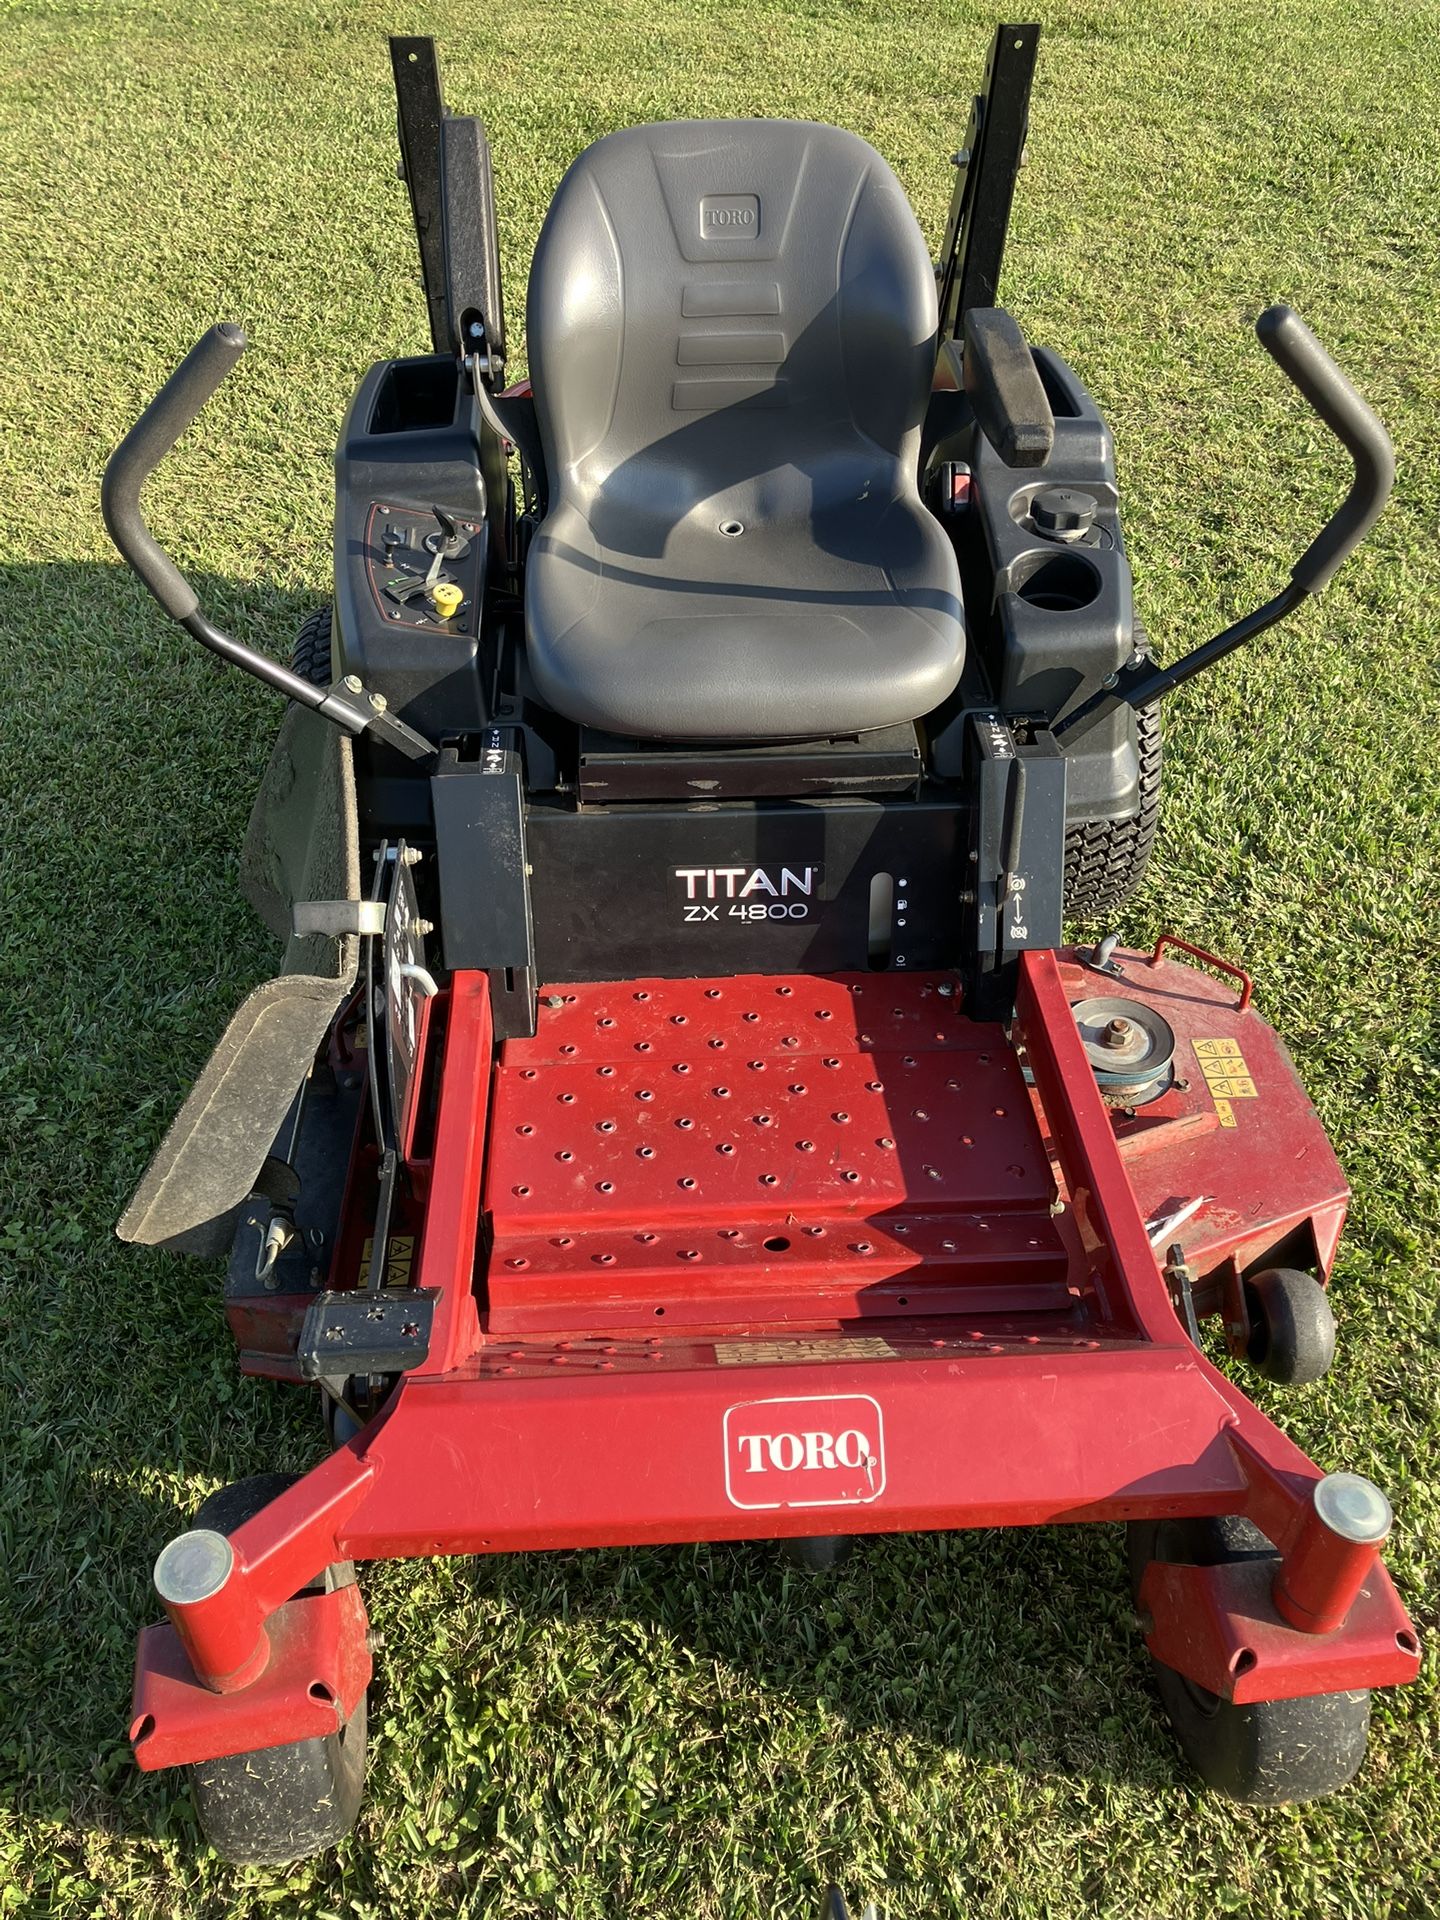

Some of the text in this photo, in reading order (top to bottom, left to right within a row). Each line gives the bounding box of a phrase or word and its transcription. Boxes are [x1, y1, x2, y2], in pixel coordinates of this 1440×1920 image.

[705, 208, 755, 226] TORO
[675, 867, 812, 899] TITAN
[683, 903, 809, 922] ZX 4800
[737, 1429, 871, 1474] TORO
